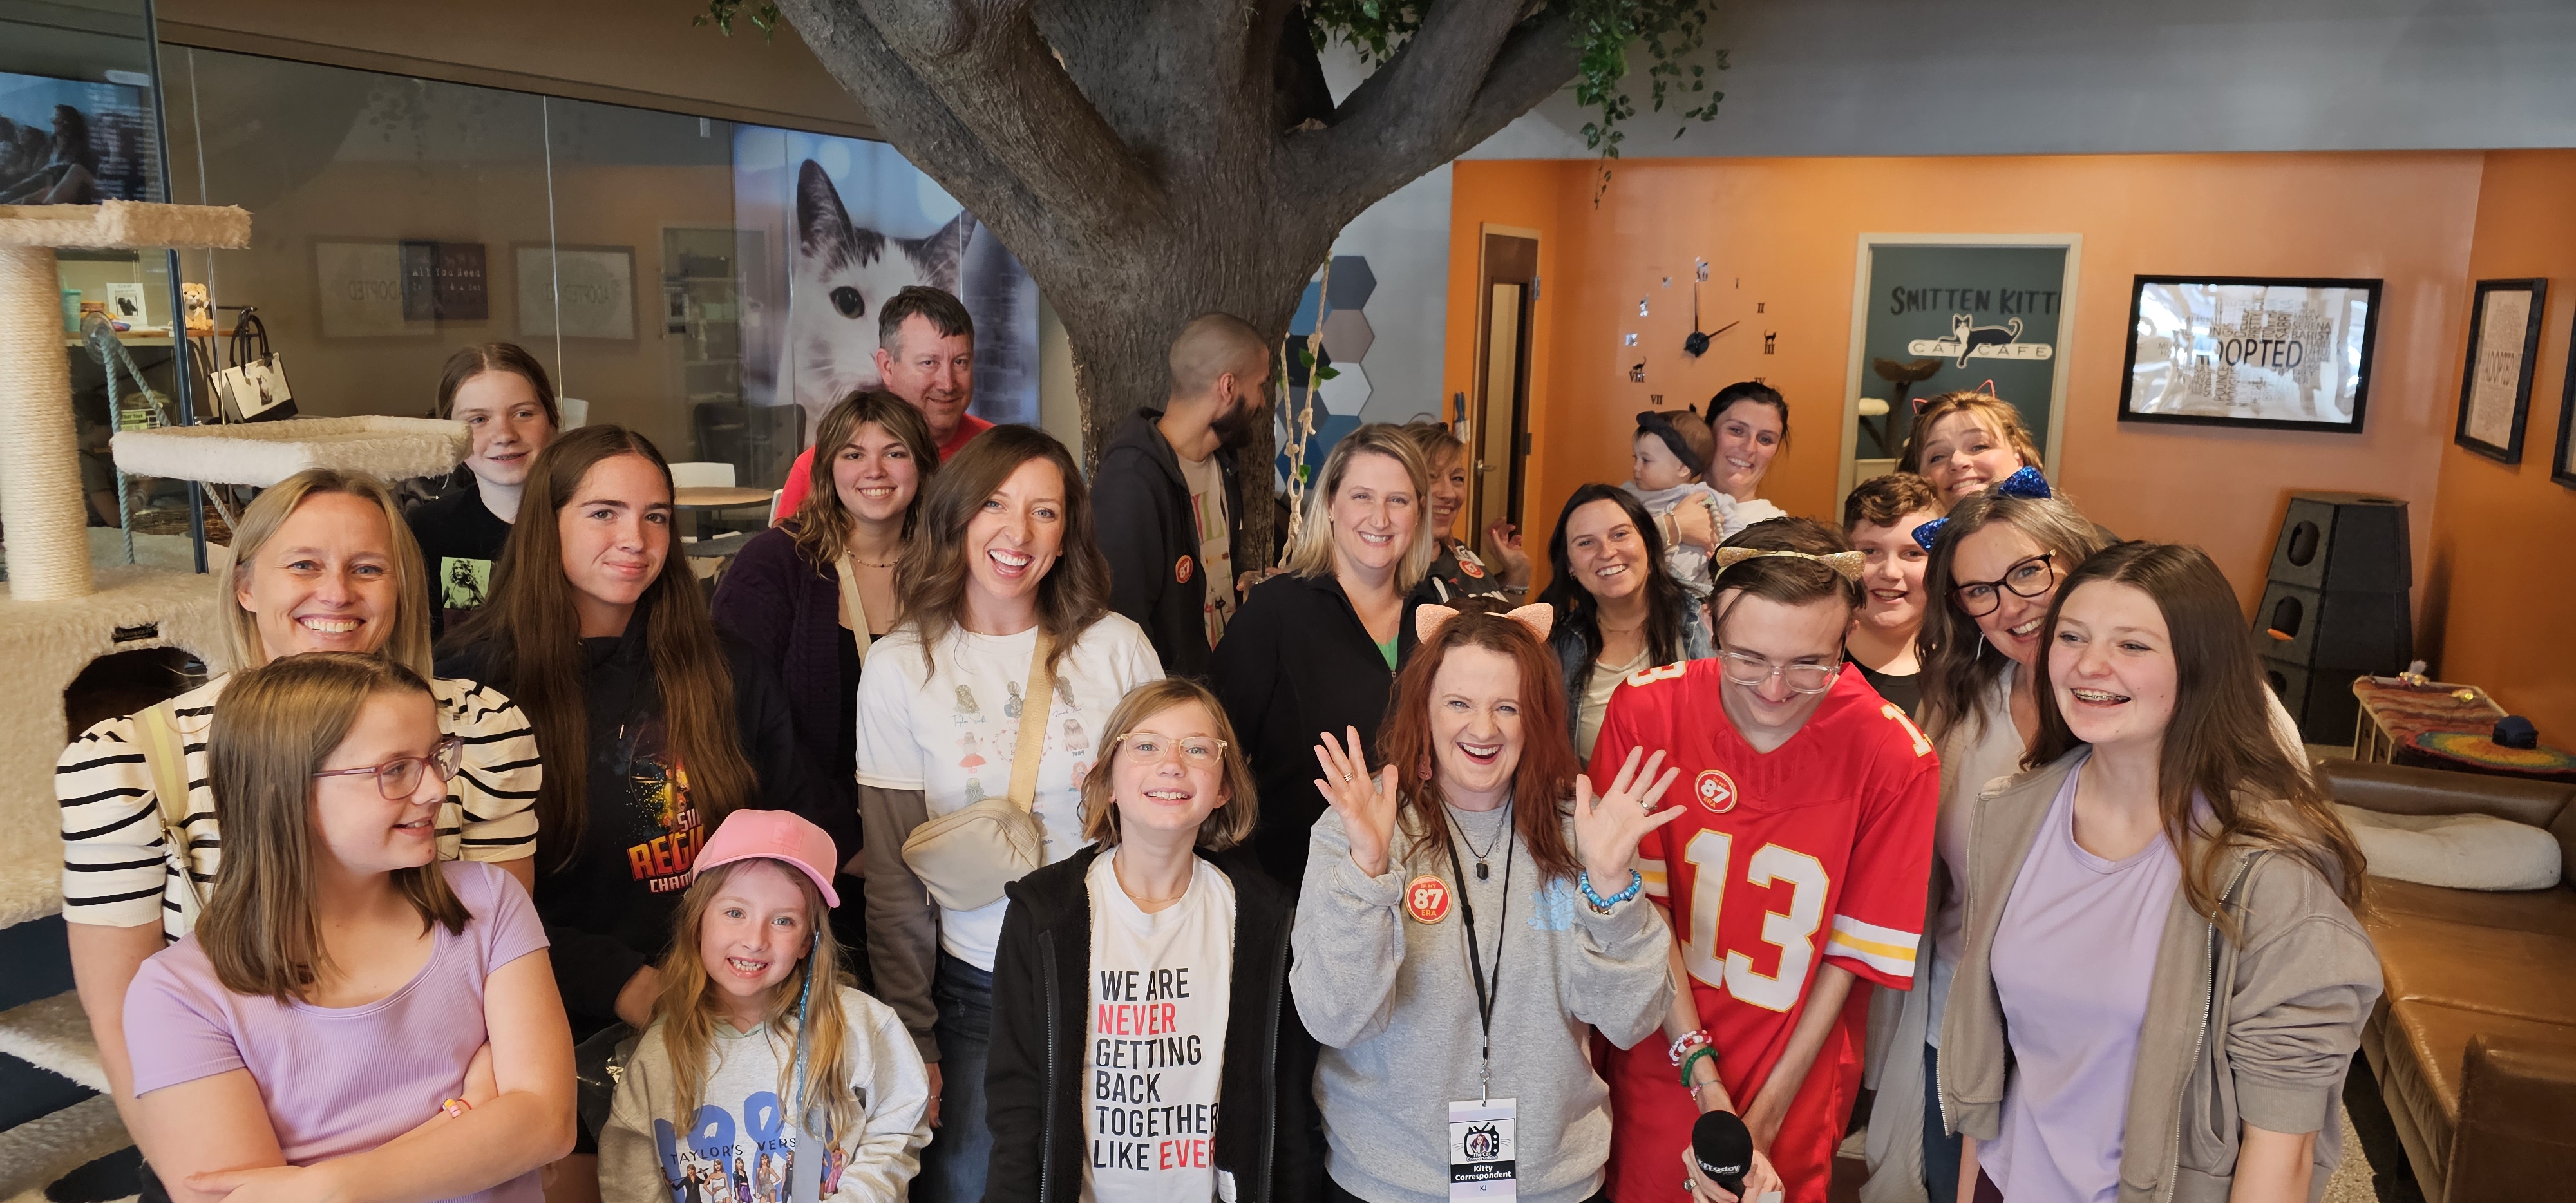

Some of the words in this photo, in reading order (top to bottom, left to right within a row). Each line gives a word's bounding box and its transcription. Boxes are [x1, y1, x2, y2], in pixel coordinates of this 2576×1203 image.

[412, 267, 431, 277] All
[435, 267, 453, 277] You
[457, 267, 481, 277] Need
[1757, 303, 1765, 313] II
[1890, 286, 1991, 316] SMITTEN
[1764, 344, 1775, 355] III
[1913, 343, 1960, 354] CAT
[1978, 345, 2048, 357] CAFE
[1651, 394, 1663, 405] VII
[1179, 561, 1190, 579] 87
[1880, 702, 1933, 757] 1
[1701, 779, 1730, 804] 87
[1703, 797, 1716, 808] ERA
[650, 867, 694, 893] CHAM
[1414, 889, 1443, 909] 87
[1681, 828, 1830, 1013] 13
[1100, 970, 1139, 1001] WE
[1145, 967, 1190, 1001] ARE
[1097, 1003, 1177, 1036] NEVER
[1095, 1034, 1202, 1070] GETTING
[1096, 1070, 1161, 1104] BACK
[1095, 1101, 1219, 1138] TOGETHER
[670, 1145, 743, 1166] TAYLOR'S
[1093, 1139, 1150, 1171] LIKE
[1160, 1132, 1216, 1171] EVER
[1455, 1170, 1511, 1181] Correspondent
